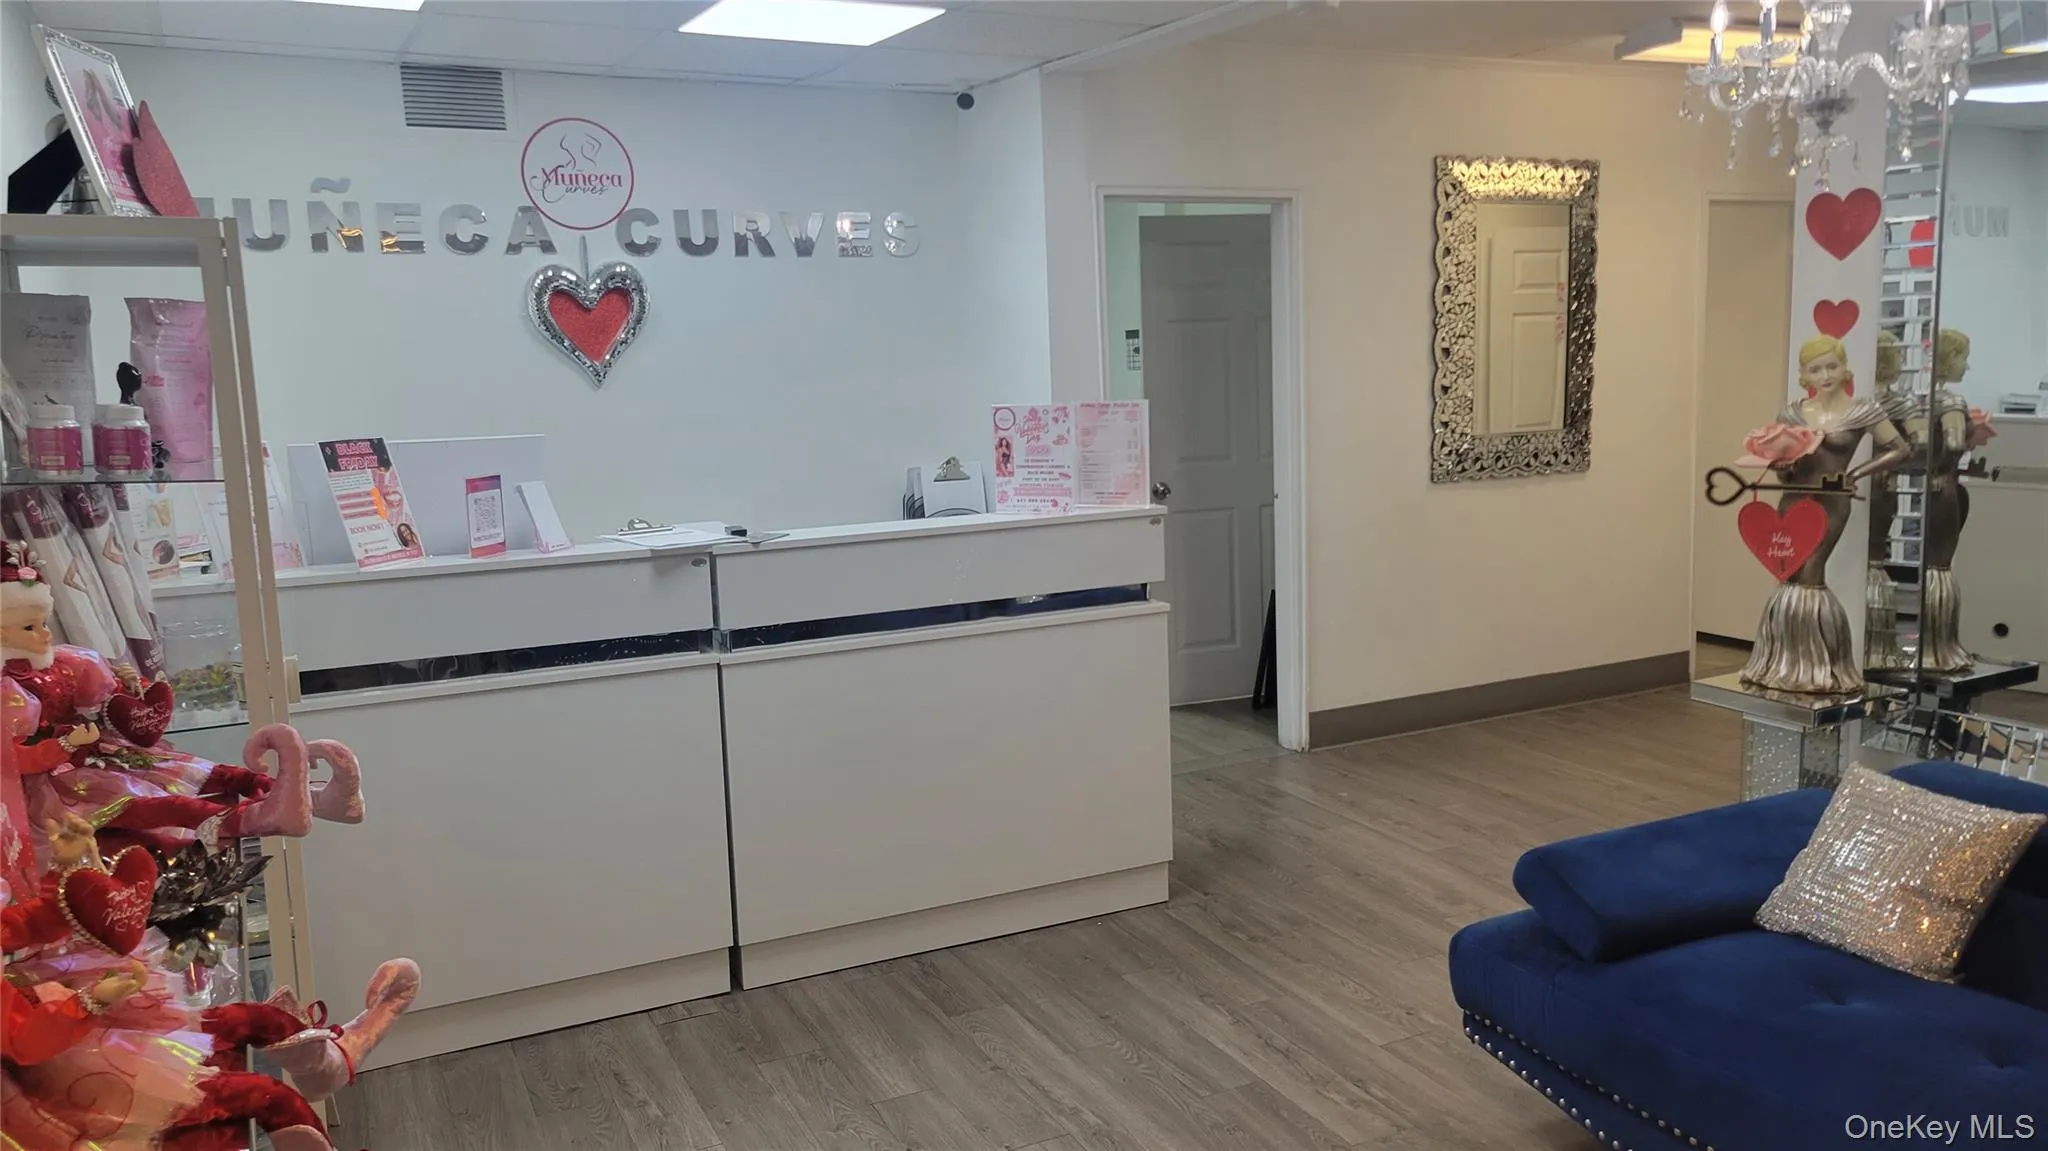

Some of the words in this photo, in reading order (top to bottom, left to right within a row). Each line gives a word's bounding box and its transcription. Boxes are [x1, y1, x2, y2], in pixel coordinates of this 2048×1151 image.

[541, 164, 623, 188] Muñeca
[190, 177, 558, 256] UÑECA
[615, 207, 920, 258] CURVES
[335, 441, 374, 456] BLACK
[338, 455, 379, 471] FRIDAY
